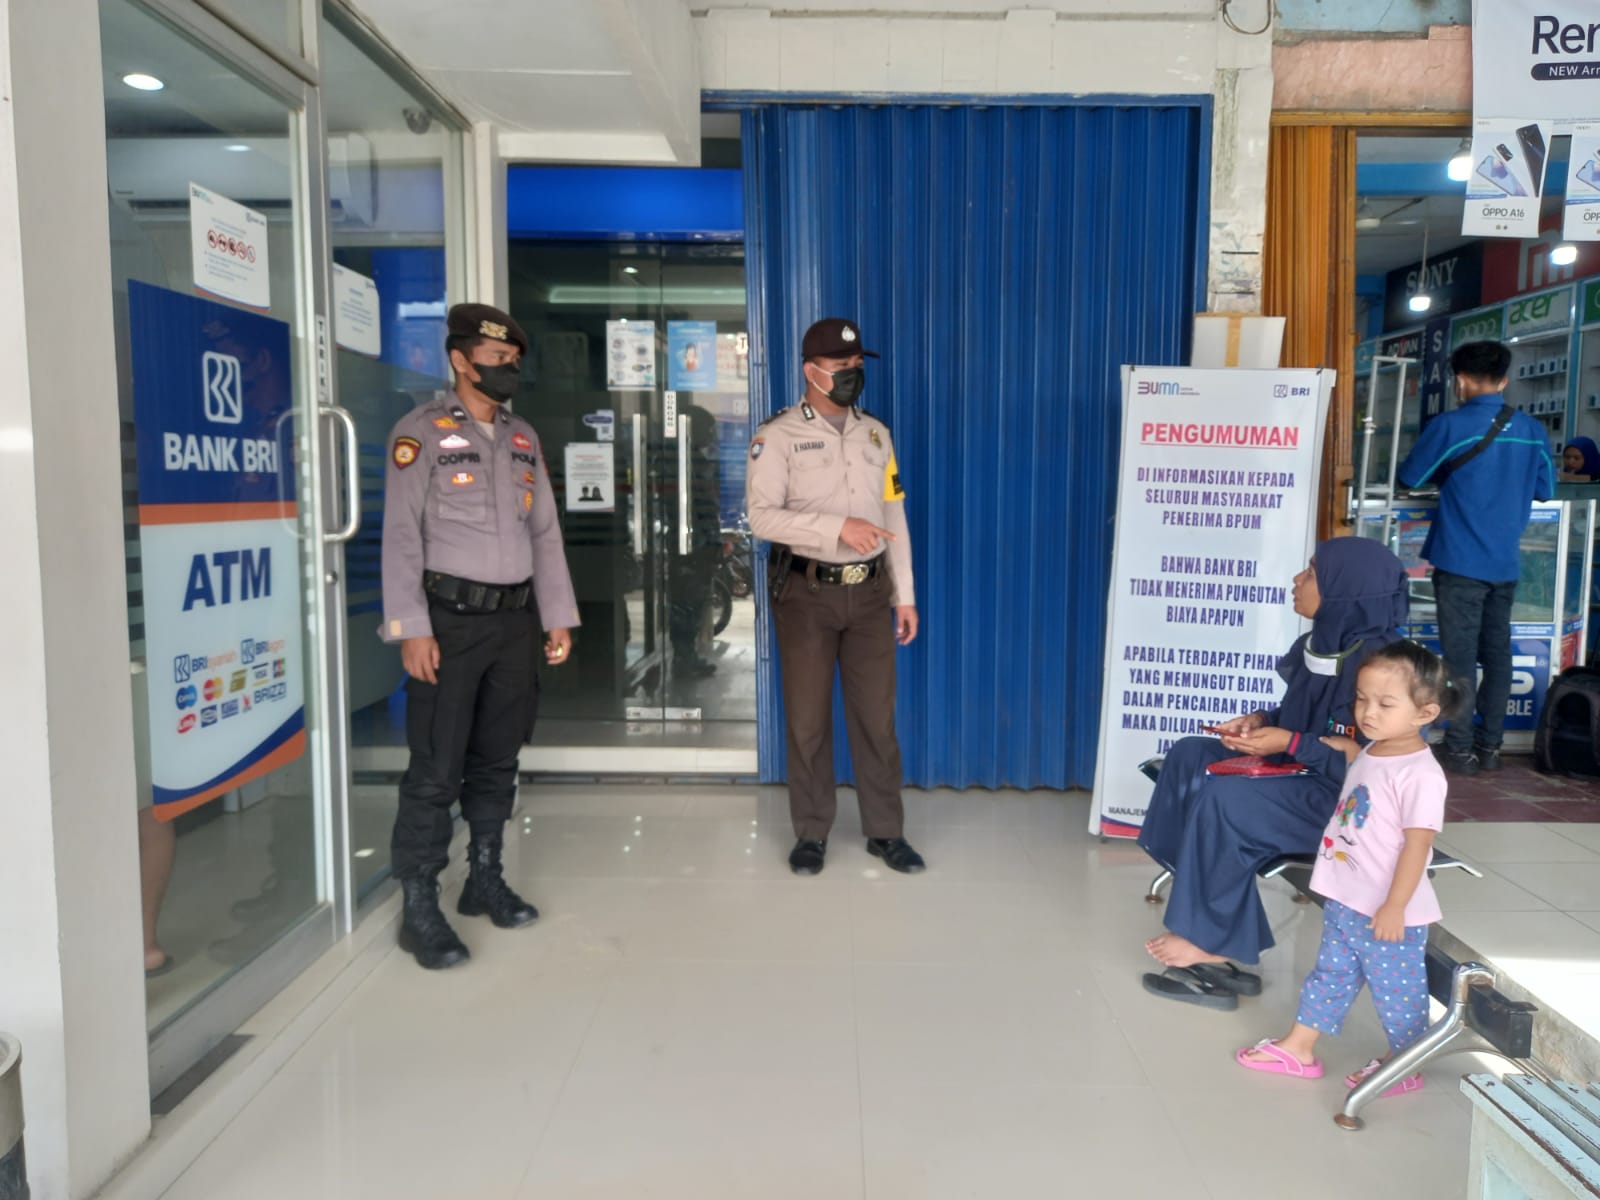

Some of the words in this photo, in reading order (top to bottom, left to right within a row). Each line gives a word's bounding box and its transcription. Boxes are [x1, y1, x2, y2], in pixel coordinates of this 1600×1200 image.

[1549, 66, 1579, 77] NEW
[1482, 207, 1508, 217] OPPO
[1509, 208, 1525, 218] A16
[1405, 257, 1459, 296] SONY
[1509, 290, 1561, 325] acer
[317, 320, 327, 387] TARIK
[1291, 387, 1310, 397] BRI
[1141, 422, 1299, 447] PENGUMUMAN
[164, 432, 240, 472] BANK
[243, 438, 278, 473] BRI
[1137, 467, 1149, 482] DI
[1153, 468, 1244, 486] INFORMASIKAN
[1248, 471, 1295, 488] KEPADA
[1145, 488, 1199, 505] SELURUH
[1202, 491, 1283, 509] MASYARAKAT
[1162, 511, 1223, 528] PENERIMA
[1226, 513, 1262, 530] BPUM
[1161, 555, 1201, 575] BAHWA
[1204, 558, 1234, 577] BANK
[1237, 560, 1257, 578] BRI
[182, 547, 271, 612] ATM
[1130, 578, 1162, 598] TIDAK
[1165, 580, 1224, 601] MENERIMA
[1226, 583, 1286, 605] PUNGUTAN
[1166, 605, 1198, 624] BIAYA
[1200, 608, 1244, 627] APAPUN
[1123, 645, 1175, 664] APABILA
[1178, 649, 1239, 669] TERDAPAT
[1129, 668, 1160, 686] YANG
[1163, 671, 1234, 691] MEMUNGUT
[1237, 676, 1274, 694] BIAYA
[1122, 690, 1164, 709] DALAM
[1167, 694, 1237, 714] PENCAIRAN
[1122, 713, 1156, 732] MAKA
[1160, 716, 1204, 735] DILUAR
